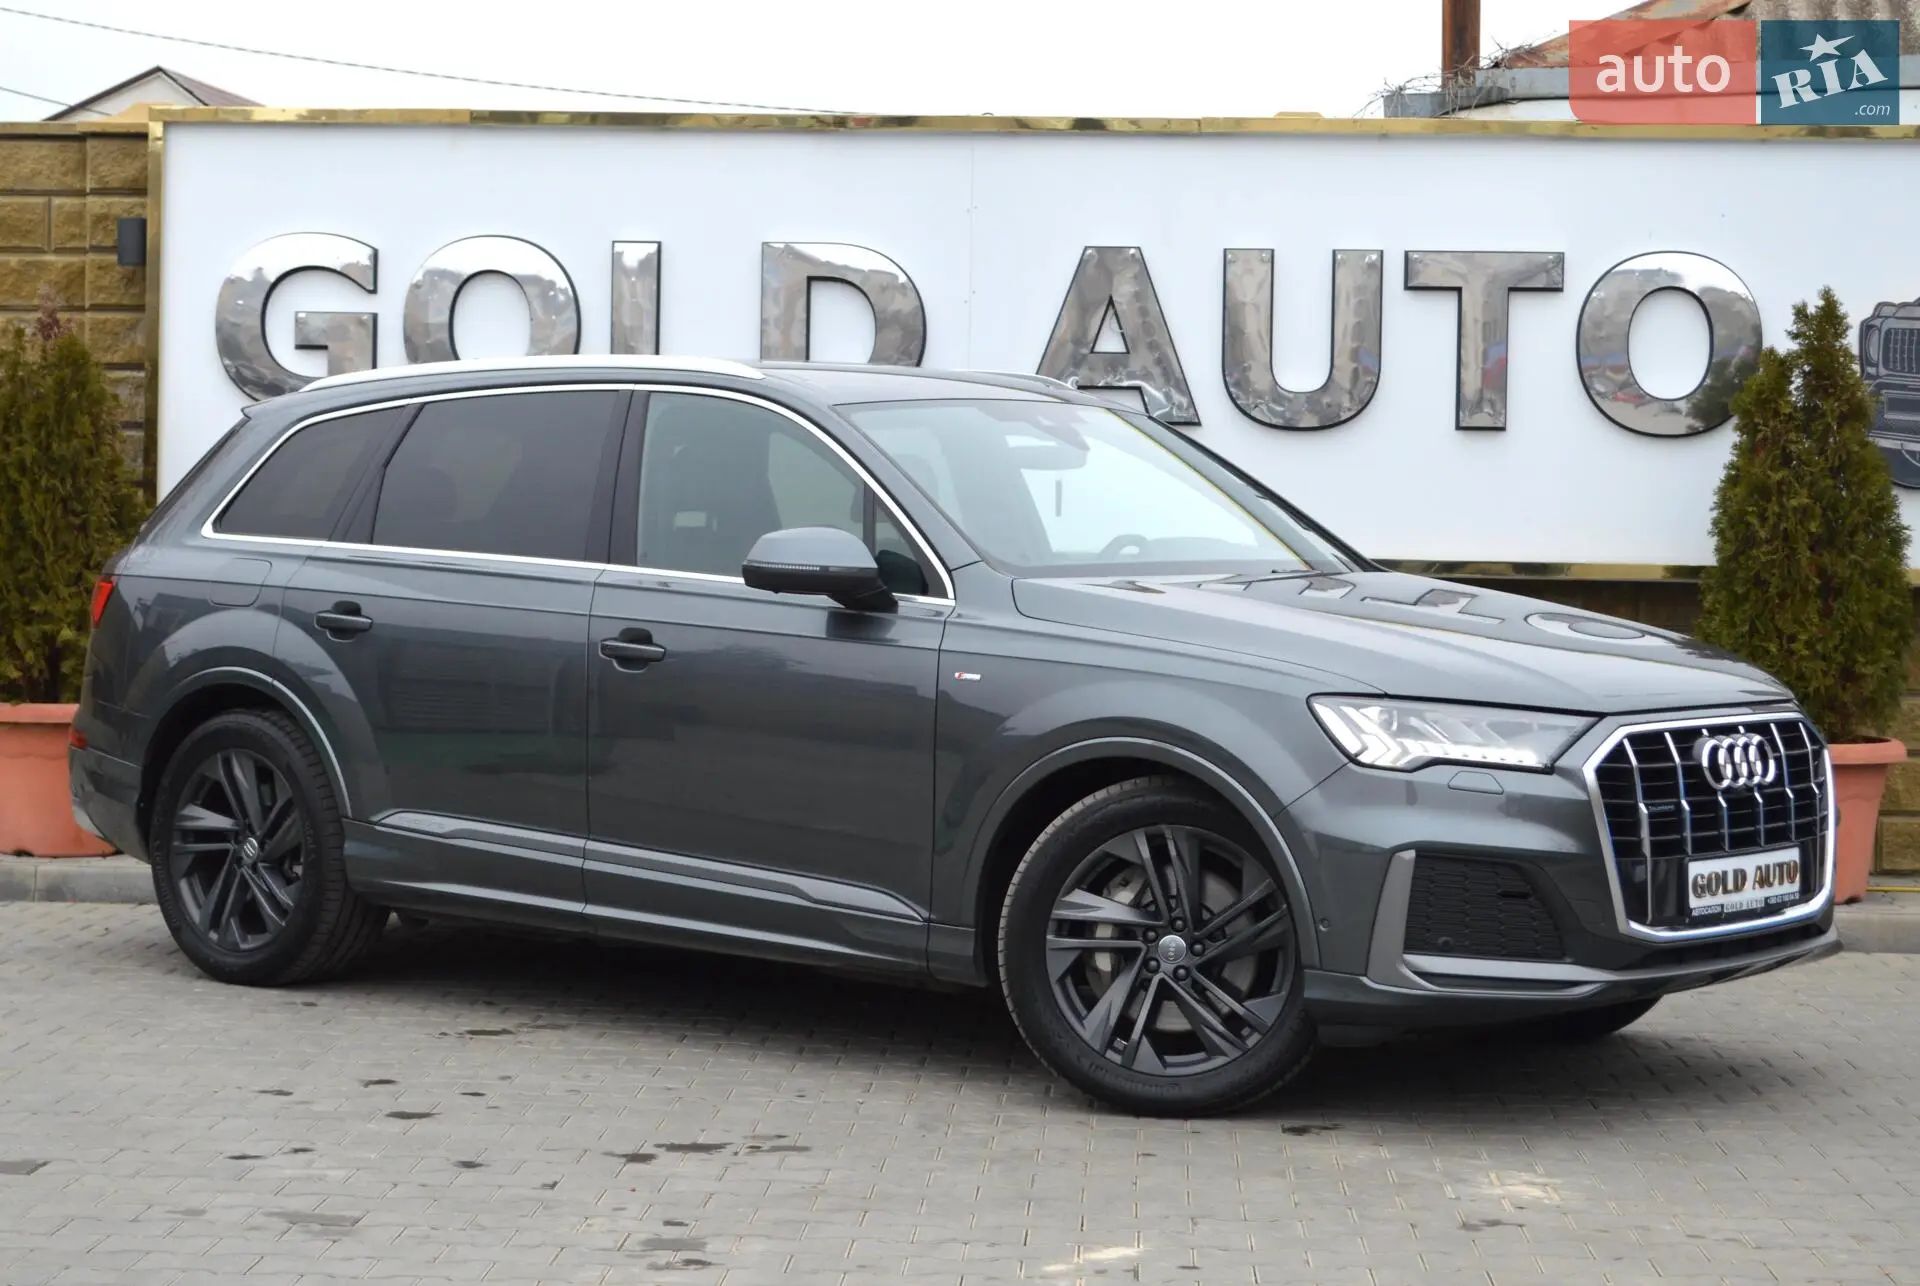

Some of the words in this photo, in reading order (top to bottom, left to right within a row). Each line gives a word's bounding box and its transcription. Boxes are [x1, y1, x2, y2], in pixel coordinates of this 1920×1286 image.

[1036, 245, 1764, 437] AUTO
[1691, 867, 1748, 899] GOLD
[1752, 859, 1799, 890] AUTO
